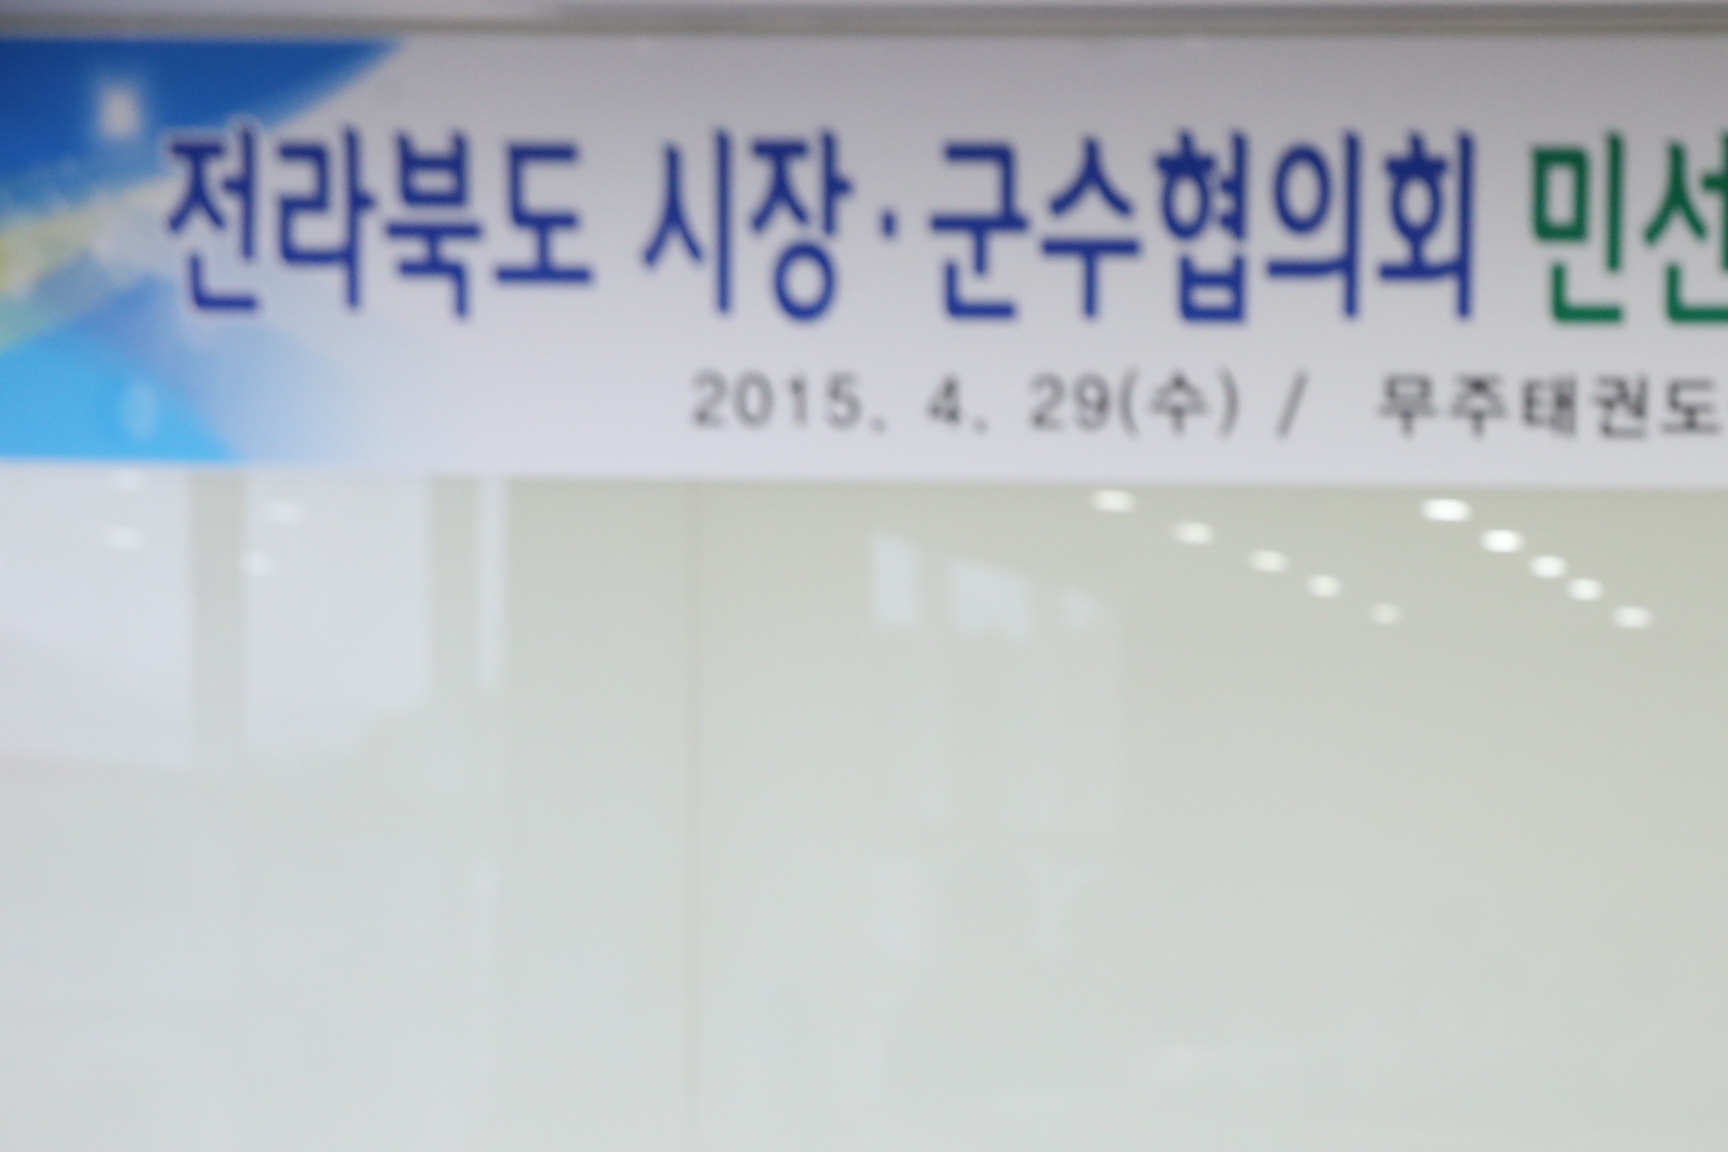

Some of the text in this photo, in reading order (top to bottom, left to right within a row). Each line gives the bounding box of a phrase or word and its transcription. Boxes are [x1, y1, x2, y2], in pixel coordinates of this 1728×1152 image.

[164, 120, 596, 320] 전라북도
[641, 125, 1475, 322] 시장·군수협의회
[692, 370, 887, 434] 2015.
[925, 372, 990, 434] 4.
[1028, 366, 1240, 438] 29(수)
